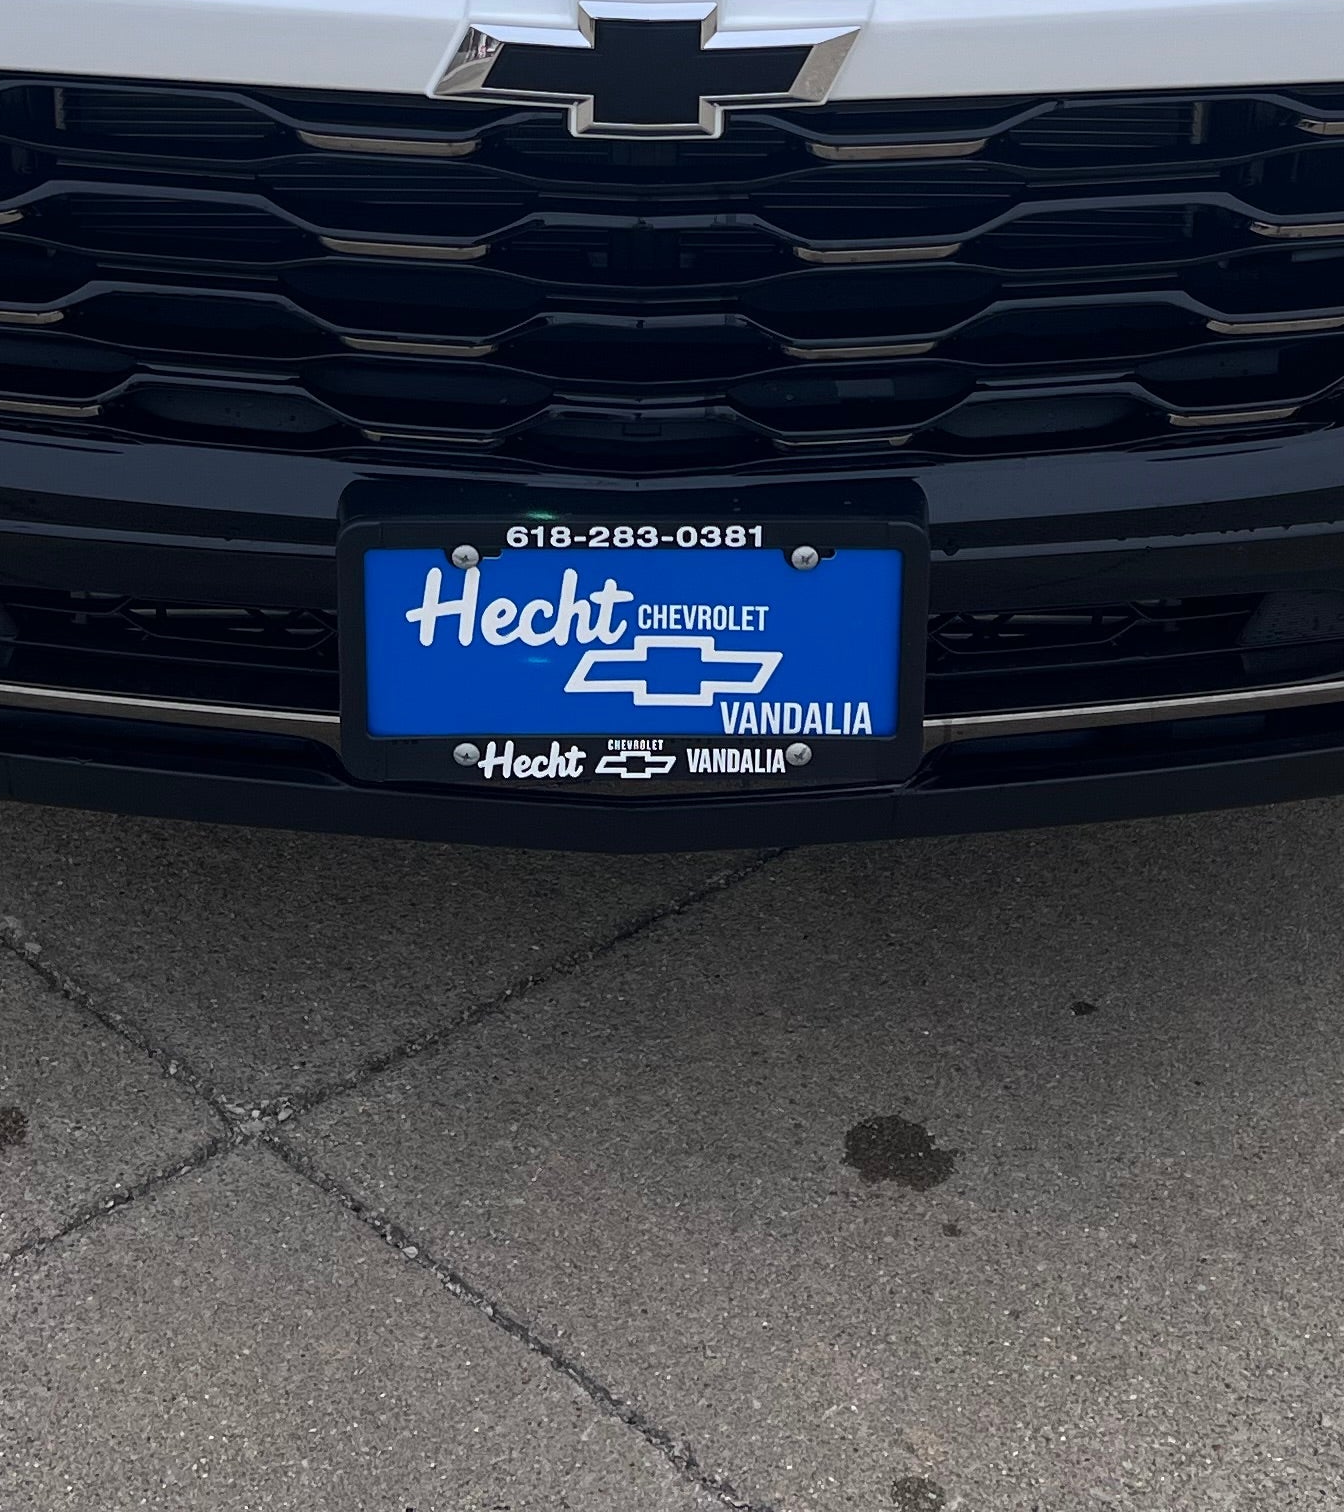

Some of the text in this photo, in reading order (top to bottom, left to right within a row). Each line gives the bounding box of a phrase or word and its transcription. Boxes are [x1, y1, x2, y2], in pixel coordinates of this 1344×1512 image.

[506, 525, 764, 548] 618-283-0381
[405, 567, 769, 647] Hecht CHEVROLET
[719, 701, 873, 735] VANDALIA
[478, 741, 786, 779] Hecht VANDALIA
[607, 739, 664, 751] CHEVROLET
